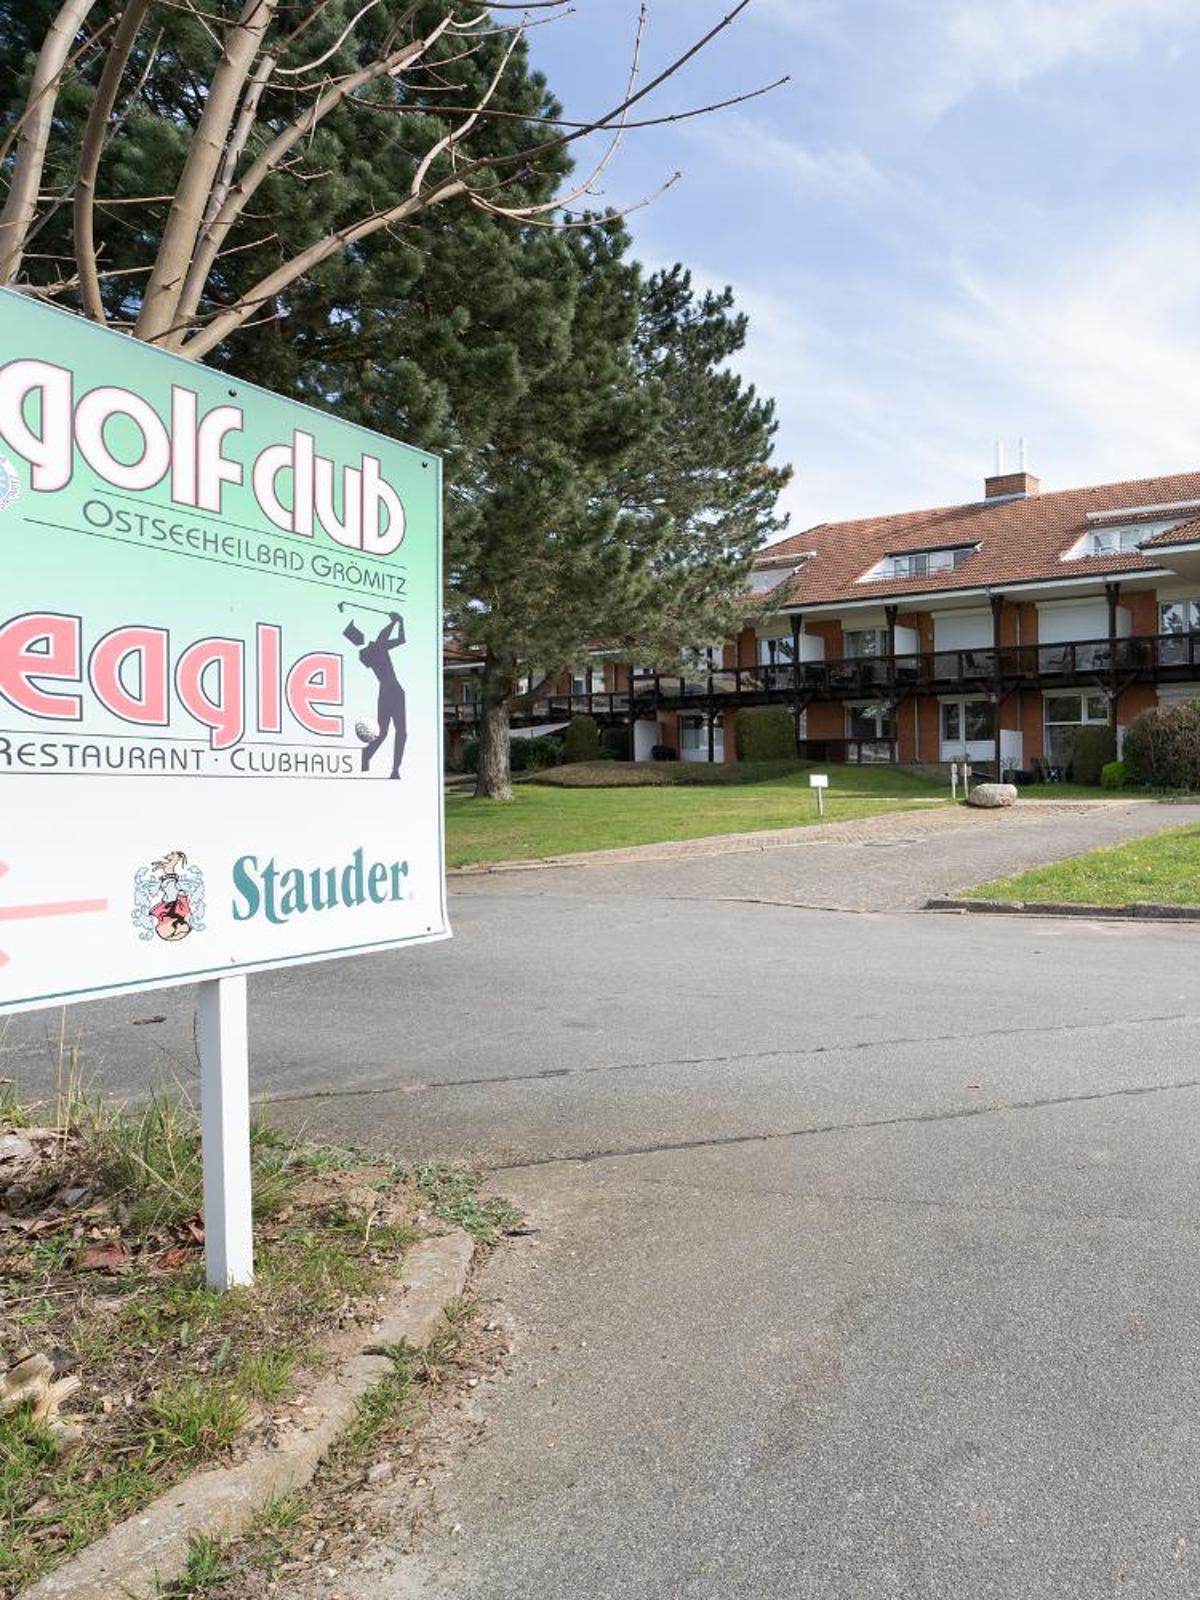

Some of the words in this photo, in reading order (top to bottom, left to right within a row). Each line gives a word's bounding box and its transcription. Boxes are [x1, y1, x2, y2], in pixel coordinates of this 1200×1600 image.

[0, 358, 244, 514] golf
[252, 428, 406, 556] club
[82, 500, 304, 571] OSTSEEHEILBAD
[311, 559, 407, 596] GRÖMITZ
[0, 611, 344, 750] eagle
[0, 736, 205, 770] RESTAURANT
[230, 748, 353, 774] CLUBHAUS
[231, 846, 409, 924] Stauder
